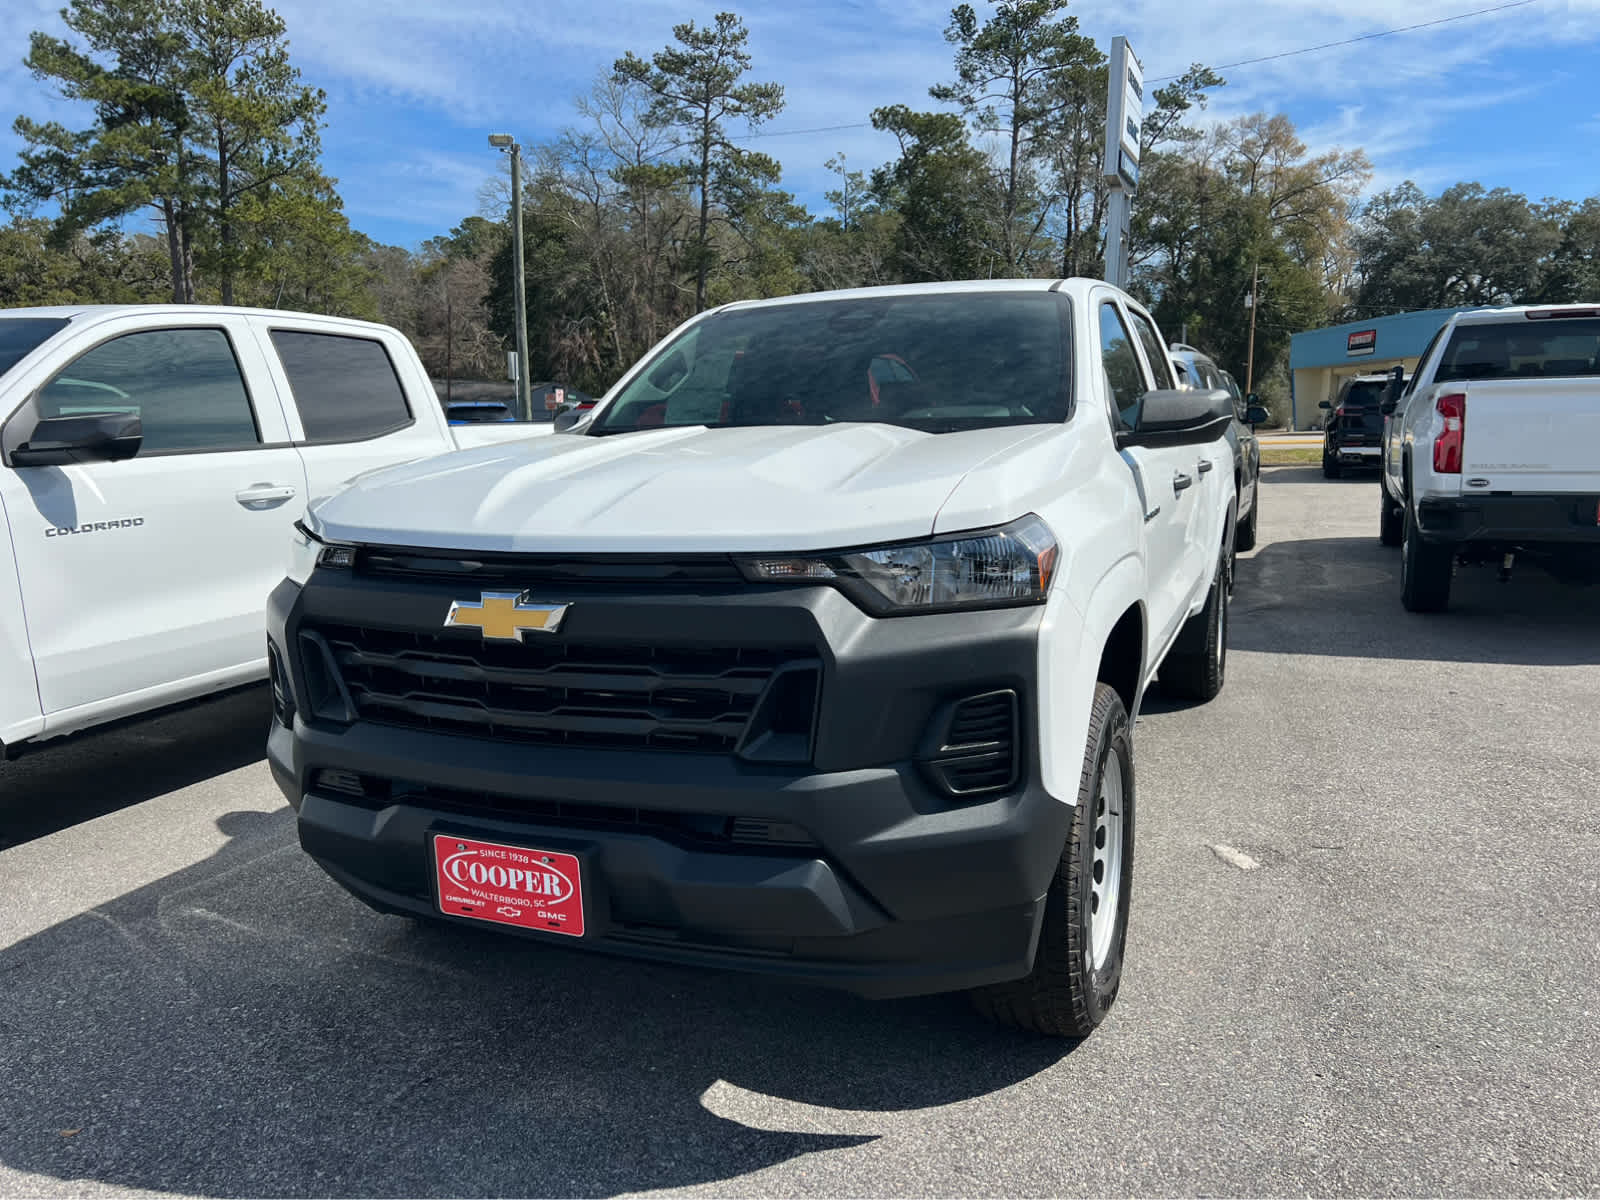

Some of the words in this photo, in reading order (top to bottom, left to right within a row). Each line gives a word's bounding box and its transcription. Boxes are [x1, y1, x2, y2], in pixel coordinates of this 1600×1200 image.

[45, 518, 144, 537] COLORADO
[479, 850, 506, 859] SINCE
[509, 854, 529, 864] 1938
[451, 859, 563, 897] COOPER
[533, 899, 545, 908] SC
[537, 910, 567, 921] GMC
